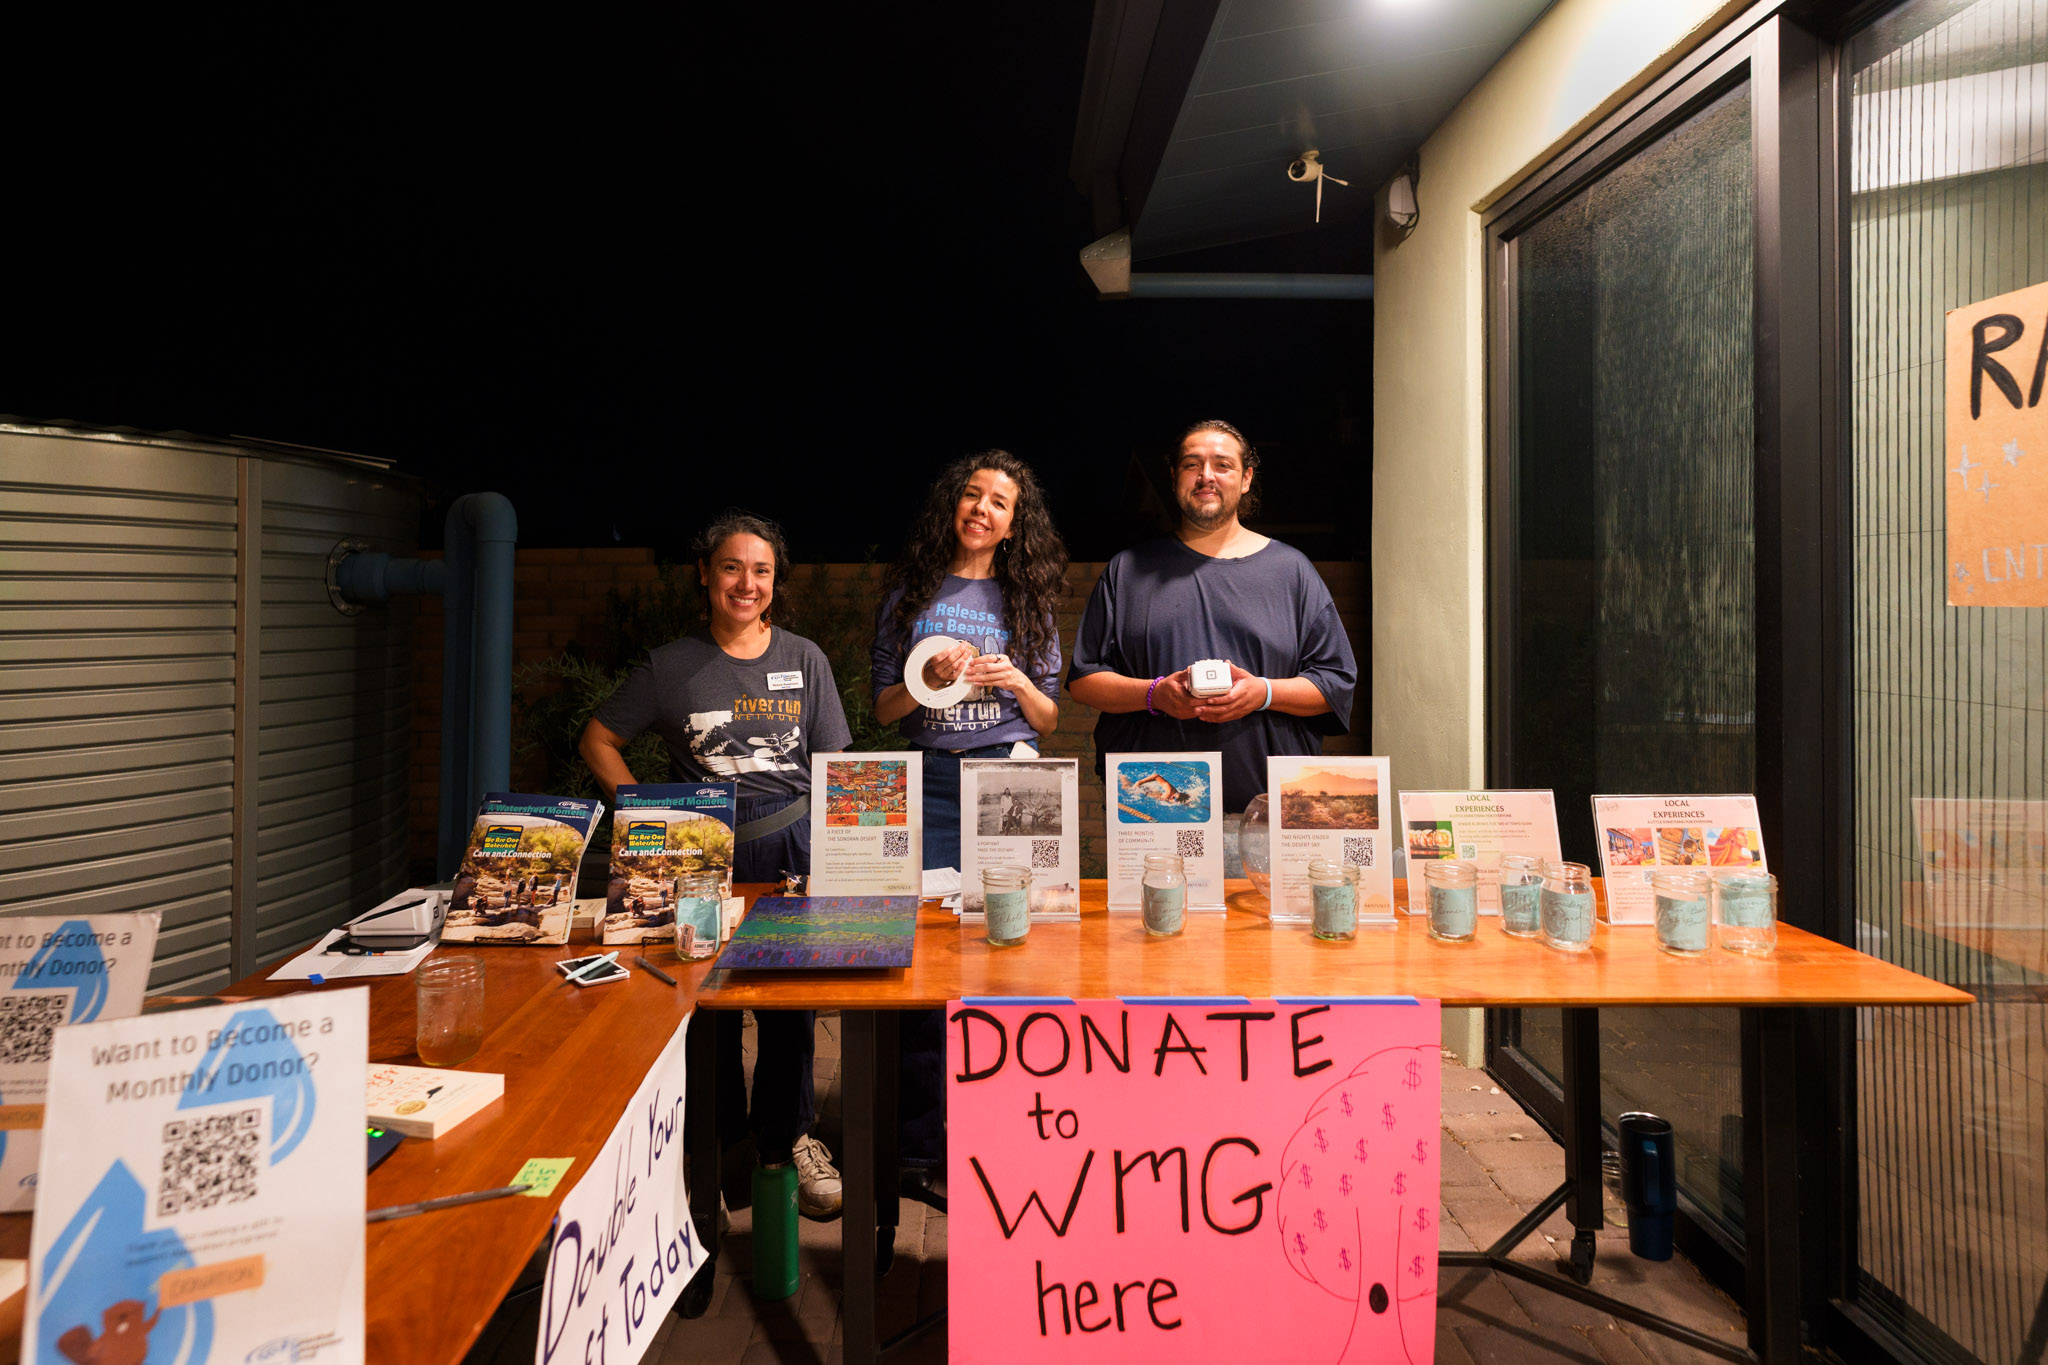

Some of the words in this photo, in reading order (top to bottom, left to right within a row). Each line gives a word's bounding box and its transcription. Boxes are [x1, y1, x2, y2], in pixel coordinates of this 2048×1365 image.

[936, 603, 996, 622] Release
[917, 619, 943, 634] The
[735, 694, 773, 712] river
[778, 699, 801, 715] run
[967, 701, 1000, 721] run
[735, 714, 800, 723] NETWORK
[495, 804, 545, 813] Watershed
[546, 806, 586, 816] Moment
[631, 798, 684, 806] Watershed
[687, 797, 727, 806] Moment
[507, 850, 552, 859] Connection
[619, 848, 638, 857] Care
[639, 848, 655, 856] and
[656, 848, 702, 856] Connection
[16, 934, 36, 948] to
[42, 932, 116, 948] Become
[121, 932, 132, 945] a
[51, 958, 117, 976] Donor?
[91, 1039, 161, 1067] Want
[171, 1034, 196, 1056] to
[207, 1020, 311, 1051] Become
[320, 1016, 333, 1034] a
[950, 1005, 1333, 1082] DONATE
[105, 1069, 220, 1103] Monthly
[226, 1052, 320, 1086] Donor?
[1028, 1092, 1079, 1140] to
[969, 1137, 1272, 1239] WMG
[544, 1126, 637, 1365] Double
[648, 1088, 683, 1177] Your
[619, 1212, 694, 1346] Today
[1036, 1260, 1182, 1336] here
